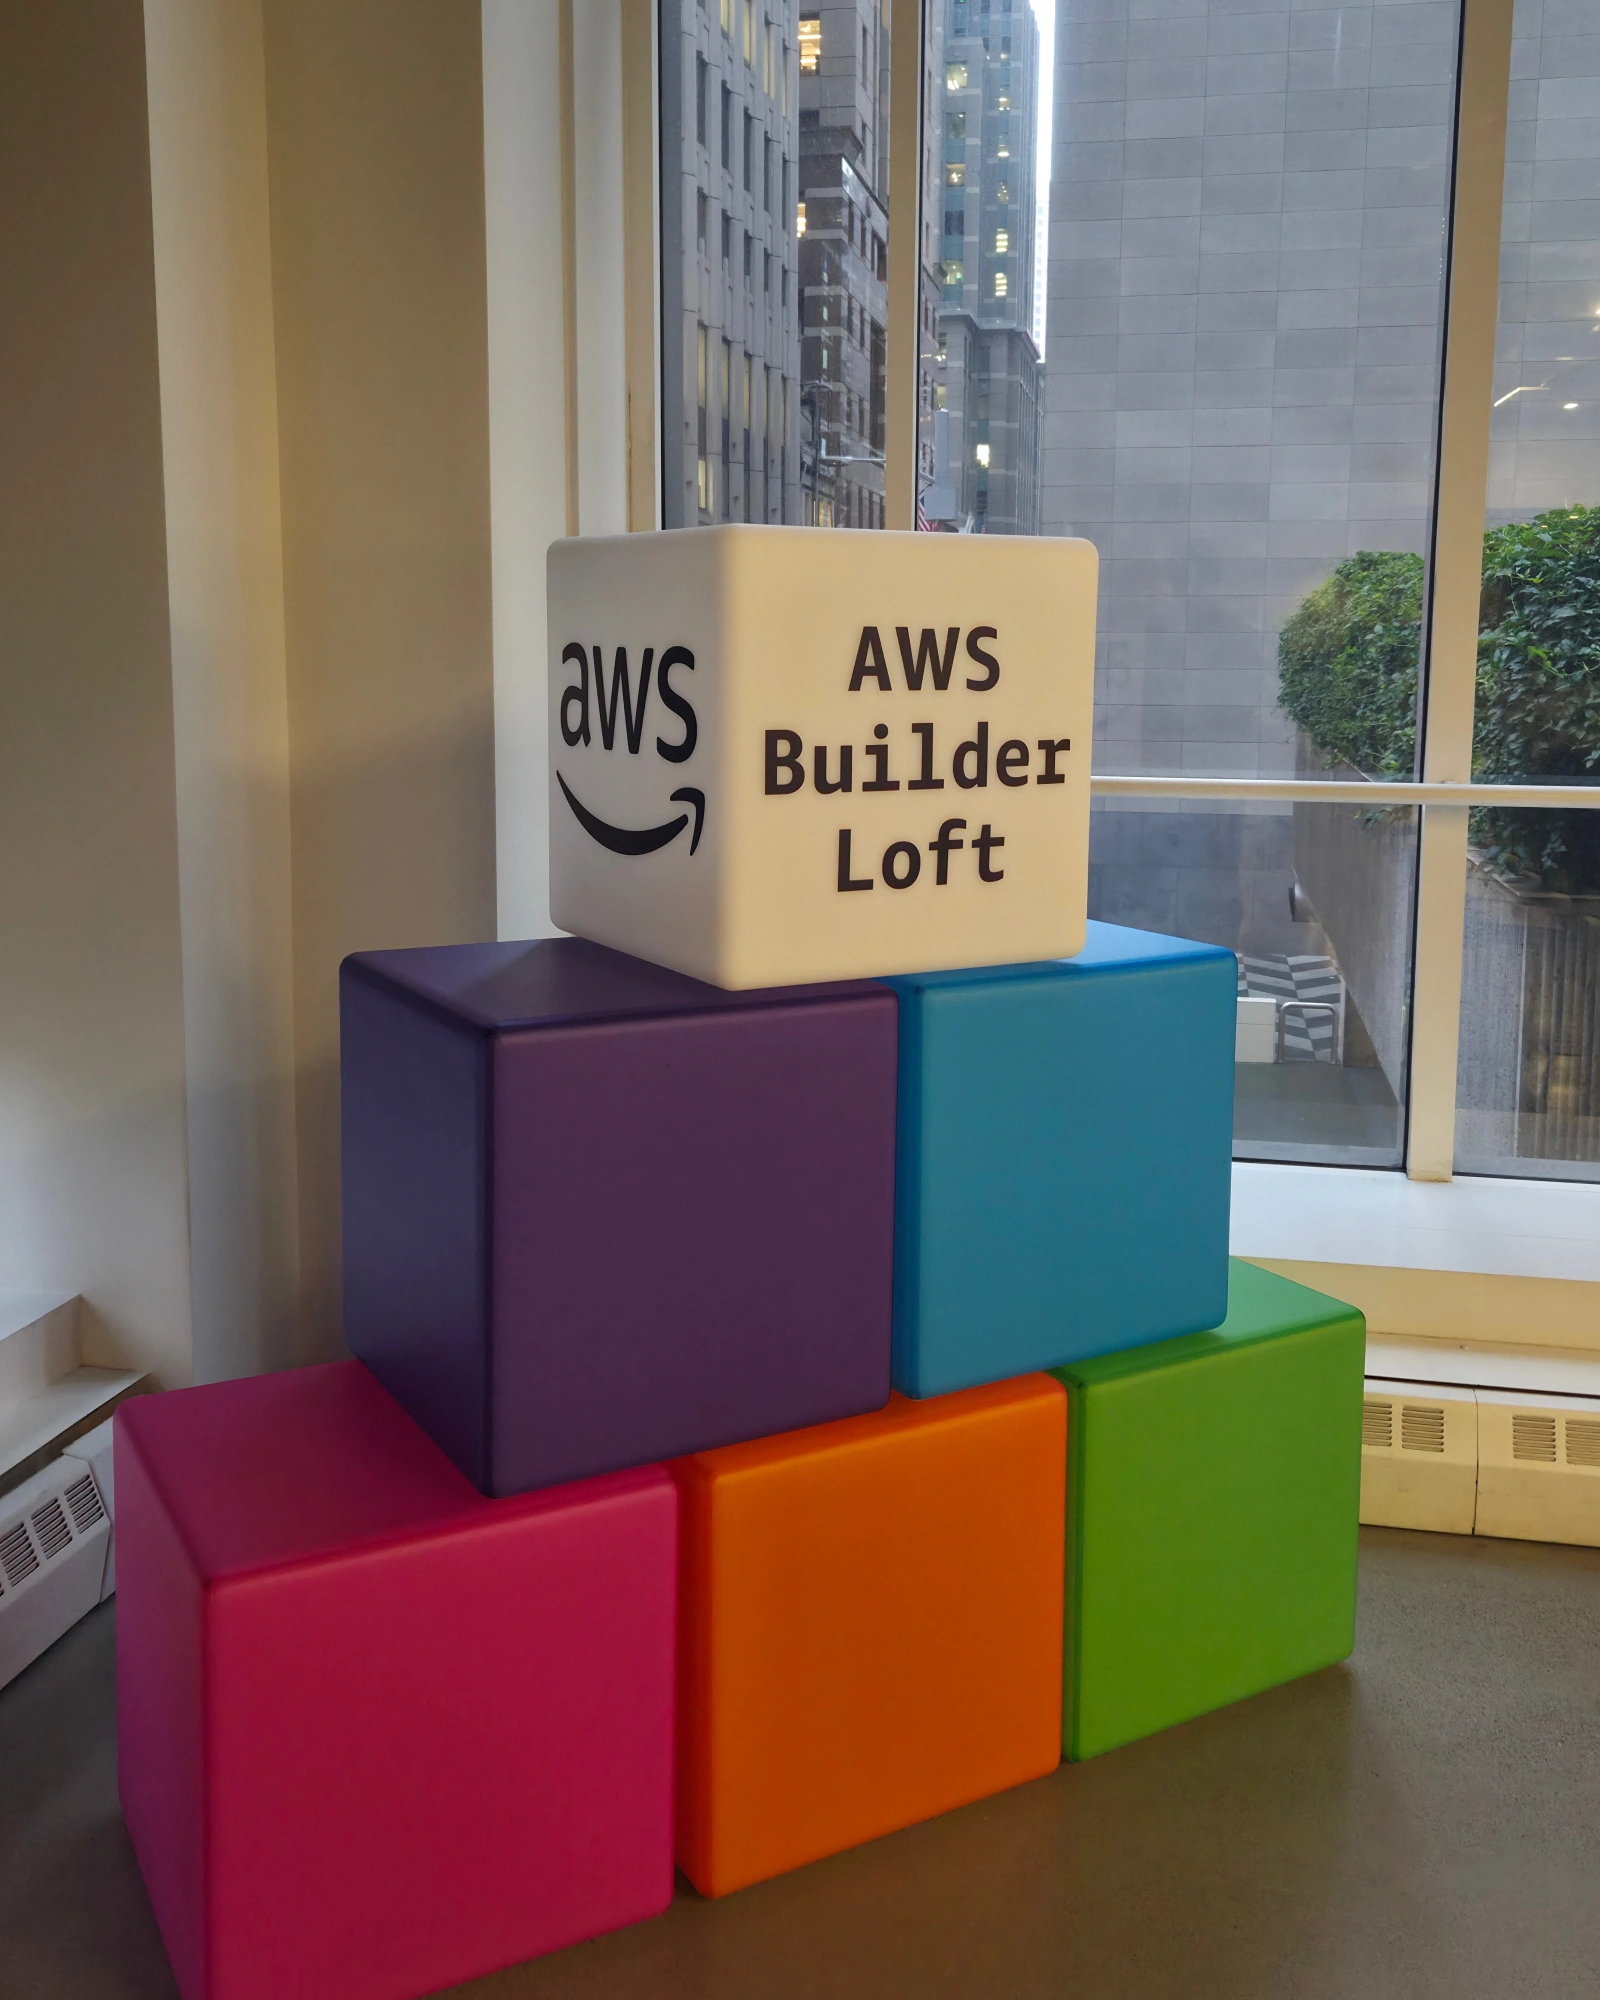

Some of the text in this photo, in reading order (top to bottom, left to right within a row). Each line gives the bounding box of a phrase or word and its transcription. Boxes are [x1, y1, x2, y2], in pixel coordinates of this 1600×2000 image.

[848, 626, 1001, 692] AWS
[559, 641, 698, 764] aws
[764, 721, 1071, 796] Builder
[837, 818, 1005, 893] Loft
